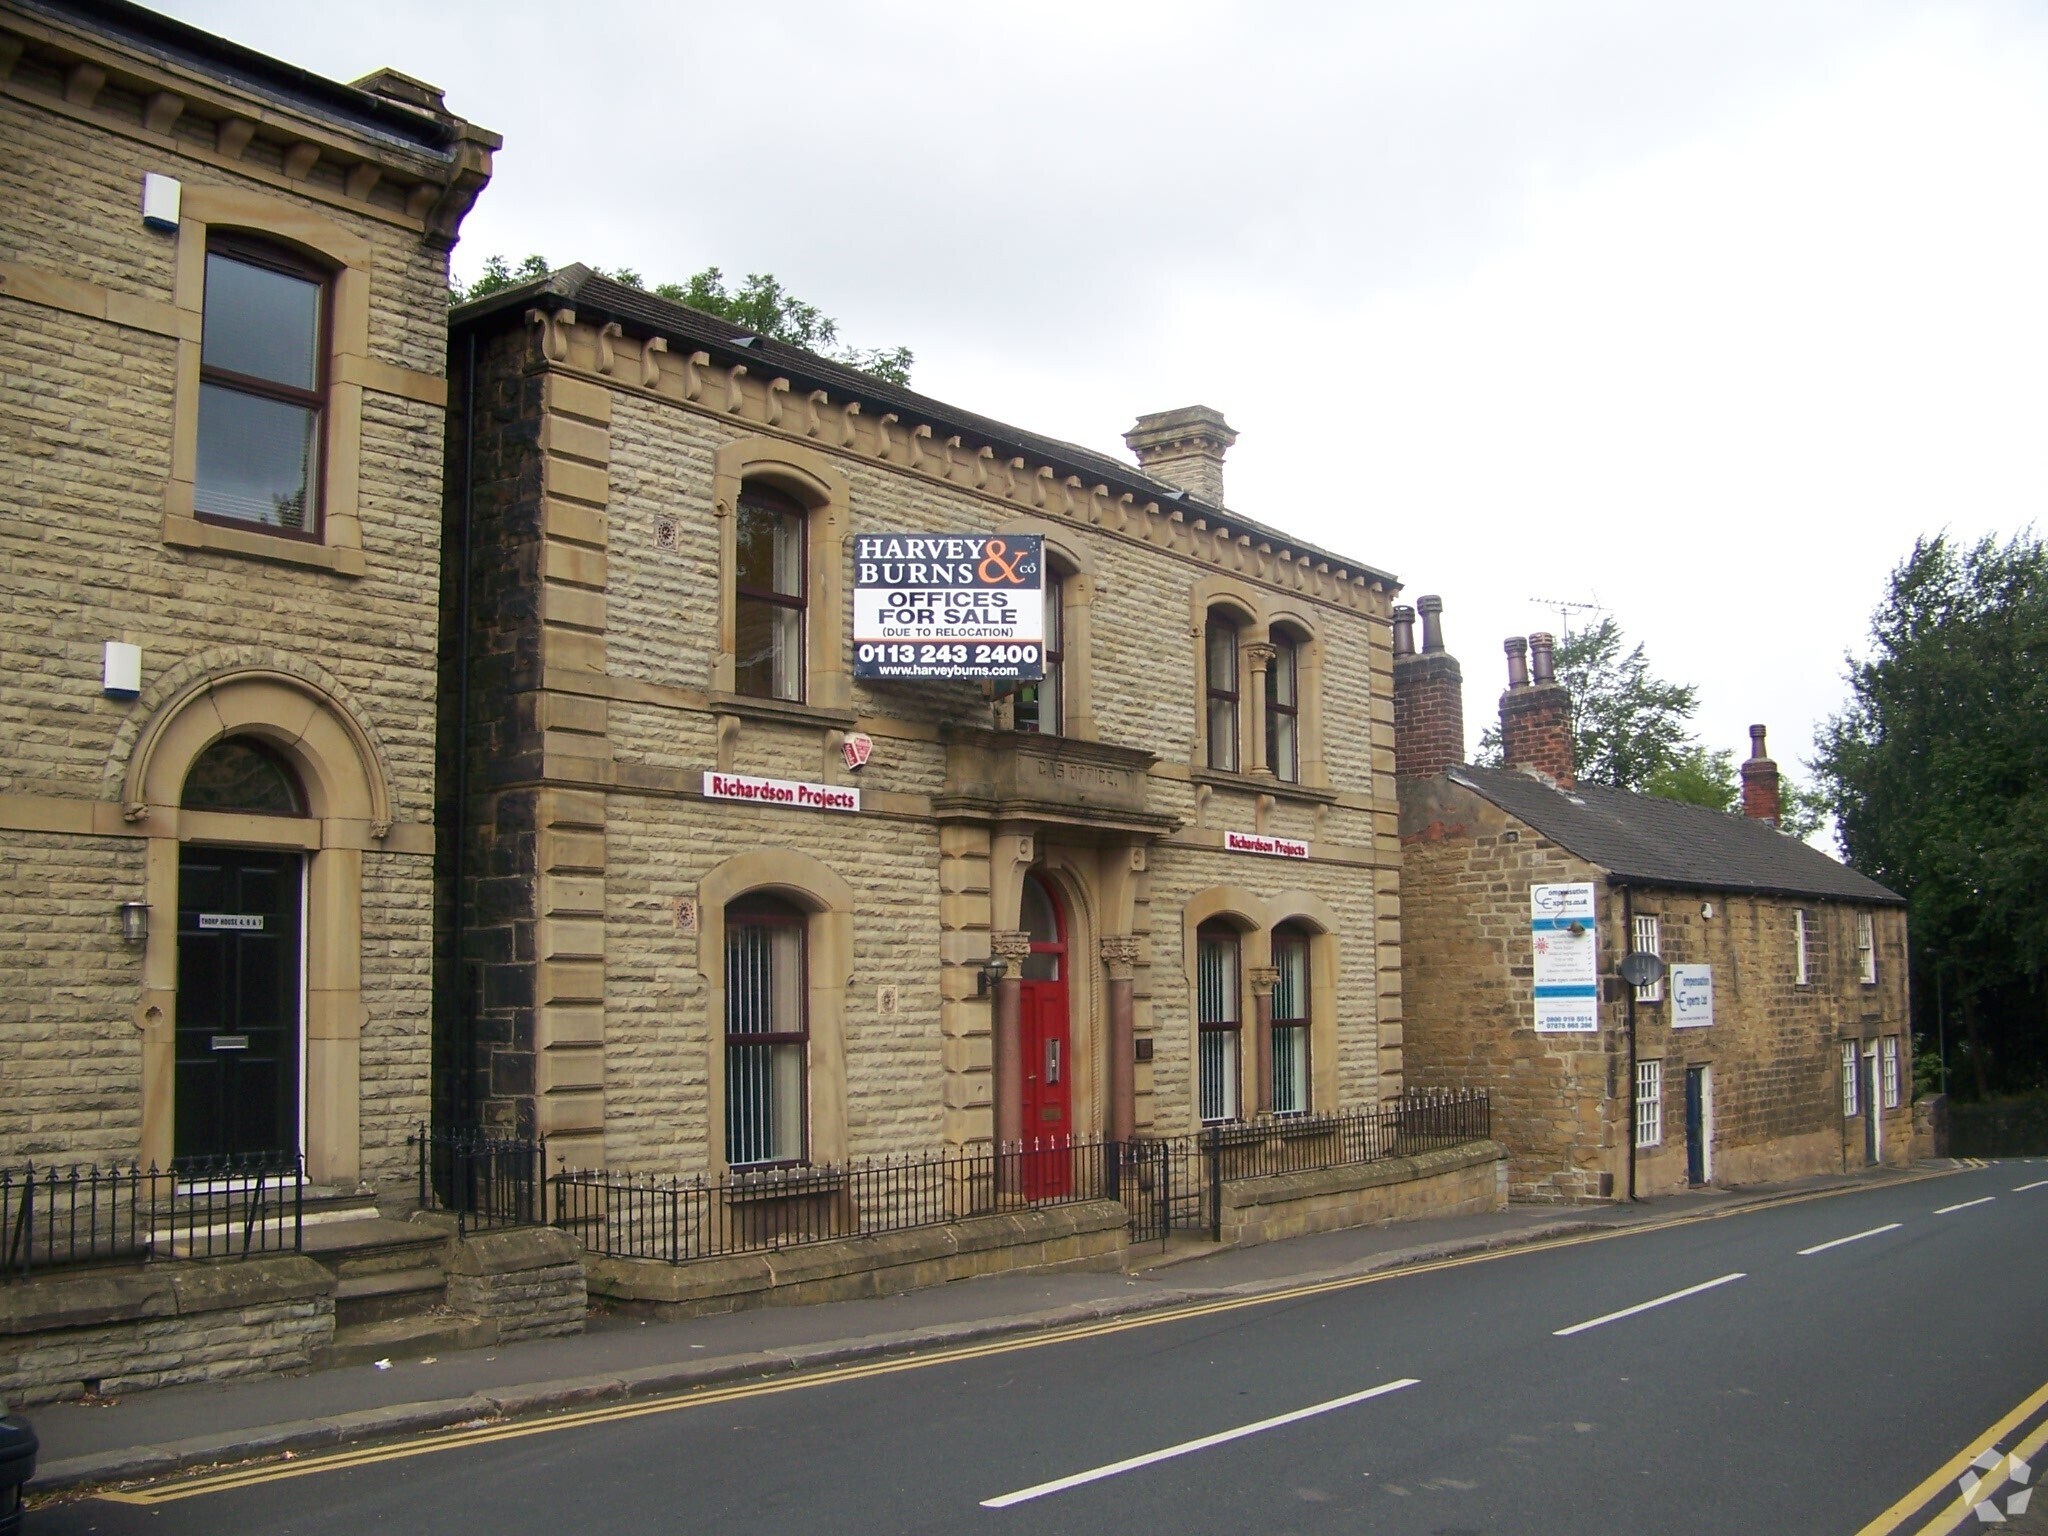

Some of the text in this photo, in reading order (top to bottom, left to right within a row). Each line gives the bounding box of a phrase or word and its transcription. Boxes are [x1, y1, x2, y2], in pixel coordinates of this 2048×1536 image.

[859, 539, 986, 559] HARVEY
[978, 540, 1028, 584] &
[859, 563, 973, 583] BURNS
[888, 592, 1008, 607] OFFICES
[879, 609, 1017, 624] FOR SALE
[882, 627, 1013, 638] (DUE TO RELOCATION)
[859, 645, 1038, 663] 0113 243 2400
[879, 665, 1018, 678] www.harveyburns.com
[713, 776, 854, 808] Richardson Projects
[1229, 834, 1306, 856] Richardson Projects
